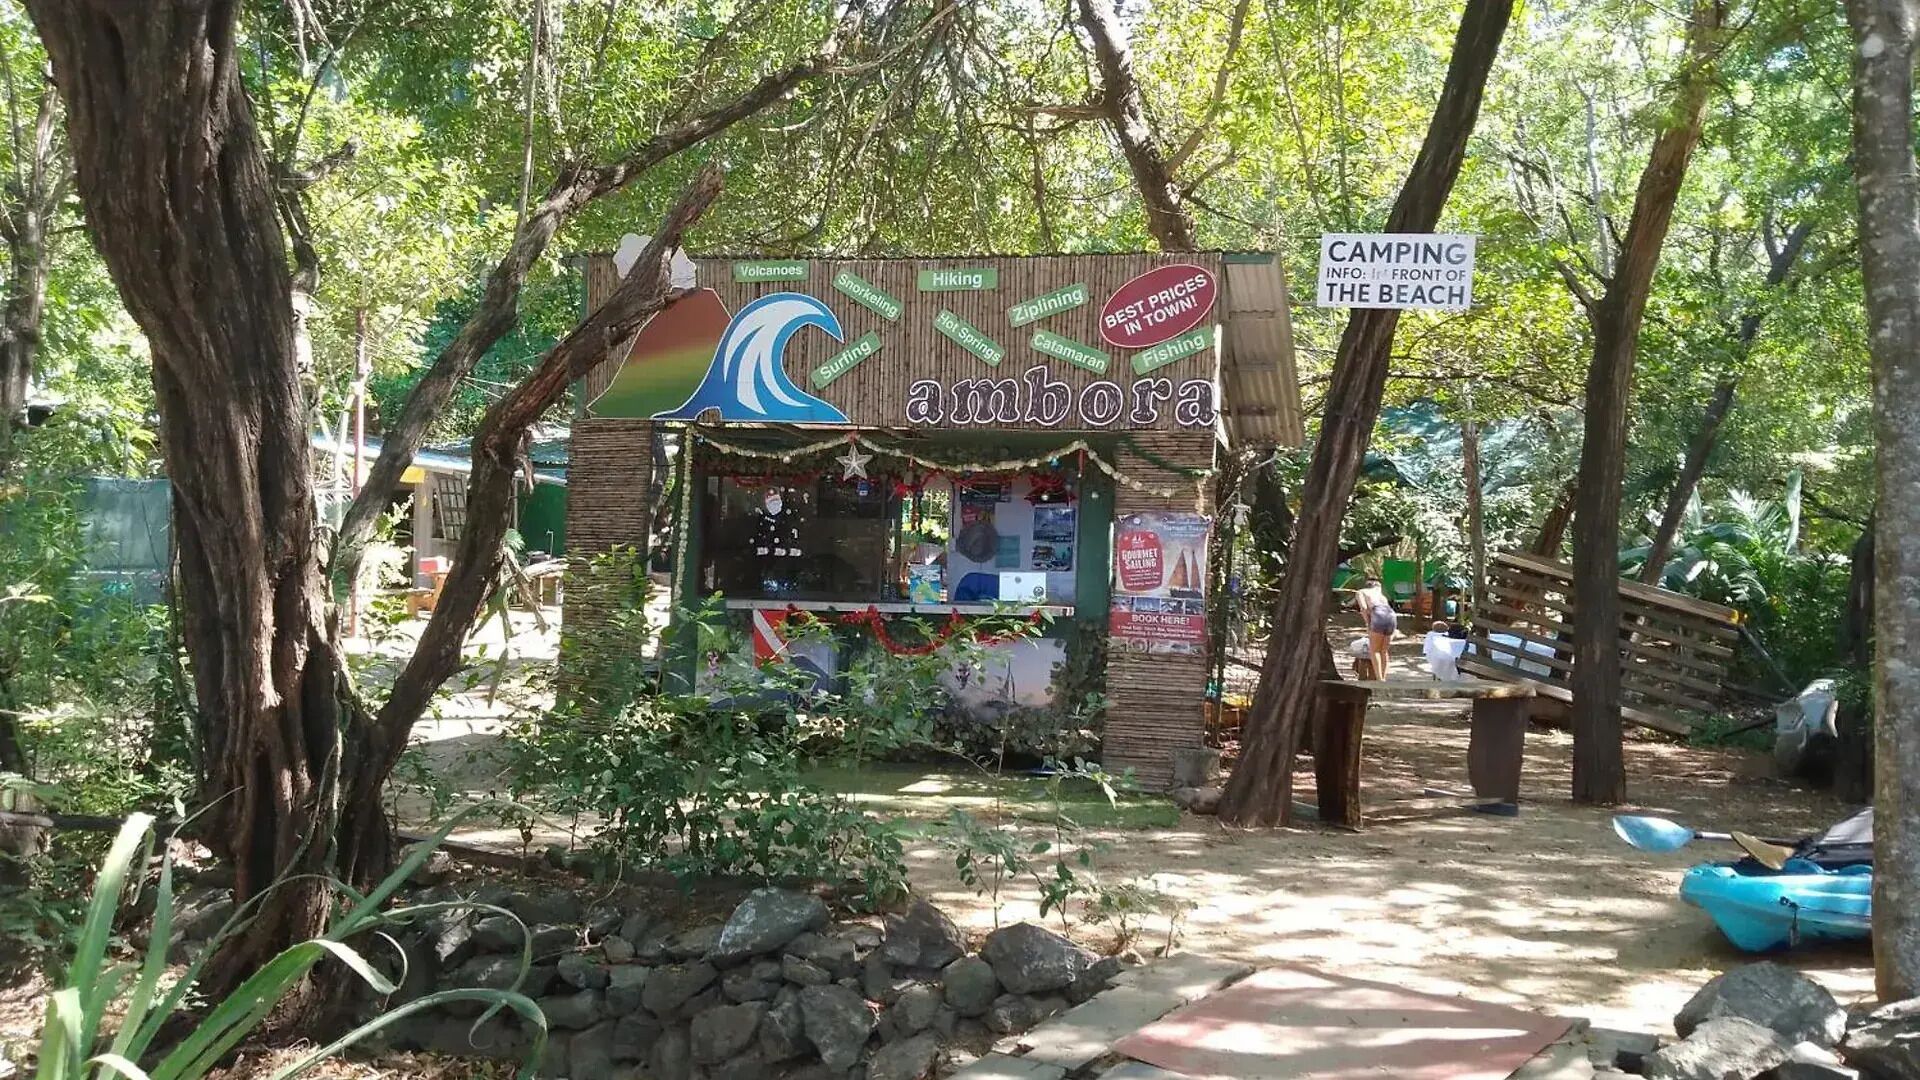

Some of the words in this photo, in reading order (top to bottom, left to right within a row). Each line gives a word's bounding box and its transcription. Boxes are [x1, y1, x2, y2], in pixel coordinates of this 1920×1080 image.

[1328, 240, 1467, 265] CAMPING
[740, 264, 803, 278] Volcanoes
[932, 271, 983, 288] Hiking
[1326, 267, 1366, 279] INFO:
[1392, 268, 1442, 281] FRONT
[1445, 269, 1466, 282] OF
[838, 273, 898, 318] Snorkeling
[1012, 288, 1084, 322] Ziplining
[1104, 300, 1146, 329] BEST
[1148, 273, 1208, 307] PRICES
[1326, 282, 1370, 303] THE
[1378, 284, 1466, 305] BEACH
[1124, 321, 1143, 337] IN
[1143, 294, 1199, 327] TOWN!
[937, 313, 960, 333] Hot
[958, 327, 1001, 362] Springs
[1033, 334, 1106, 371] Catamaran
[1142, 333, 1206, 368] Fishing
[820, 340, 872, 380] Surfing
[905, 365, 1217, 427] ambora
[1122, 549, 1158, 561] GOURMET
[1125, 559, 1157, 570] SAILING
[1132, 614, 1159, 624] BOOK
[1160, 616, 1190, 626] HERE!
